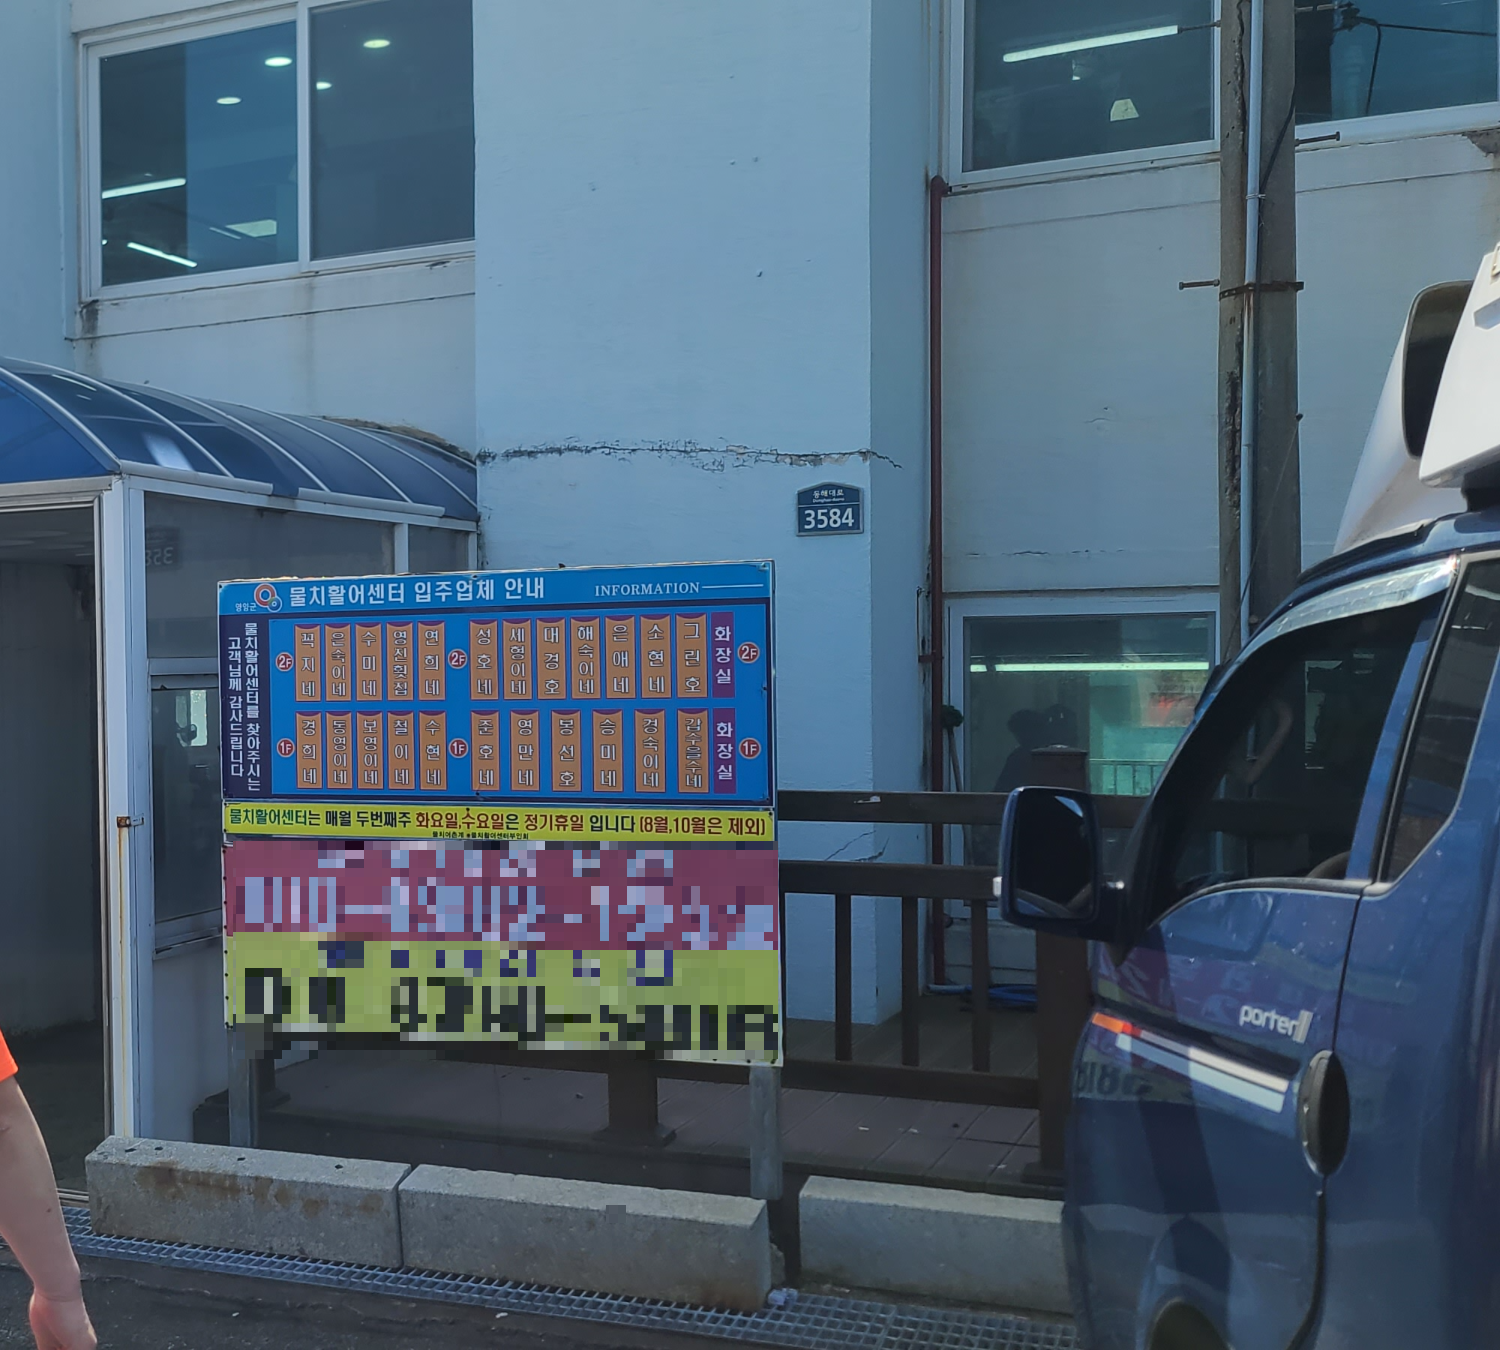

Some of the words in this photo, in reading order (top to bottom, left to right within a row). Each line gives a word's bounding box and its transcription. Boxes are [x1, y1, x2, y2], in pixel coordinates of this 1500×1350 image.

[804, 507, 854, 529] 3584
[289, 582, 405, 607] 물치활어센터
[415, 579, 494, 603] 입주업체
[504, 577, 544, 600] 안내
[595, 581, 700, 597] INFORMATION
[228, 637, 242, 691] 고객님께
[244, 622, 259, 719] 물치활어센터를
[278, 655, 292, 669] 2F
[331, 632, 346, 697] 은숙이네
[360, 631, 377, 696] 수미네
[393, 630, 408, 696] 영진횟집
[424, 629, 440, 696] 연희네
[450, 653, 466, 666] 2F
[476, 628, 493, 695] 성호네
[509, 627, 526, 695] 세형이네
[544, 626, 560, 695] 대경호
[577, 625, 594, 695] 해숙이네
[612, 624, 629, 694] 은애네
[647, 624, 665, 694] 소현네
[683, 623, 700, 693] 그린호
[714, 625, 732, 684] 화장실
[741, 645, 758, 660] 2F
[229, 696, 244, 777] 감사드립니다
[246, 723, 261, 791] 찾아주시는
[280, 741, 293, 754] 1F
[302, 720, 317, 785] 경희네
[332, 720, 348, 785] 동영이네
[363, 720, 378, 785] 보영이네
[393, 719, 409, 785] 철이네
[425, 719, 441, 785] 수현네
[451, 741, 465, 754] 1F
[478, 719, 494, 786] 준호네
[517, 719, 534, 787] 영만네
[559, 718, 575, 788] 봉선호
[600, 718, 617, 788] 승미네
[642, 718, 660, 788] 경숙이네
[716, 722, 733, 780] 화장실
[742, 741, 758, 755] 1F
[229, 808, 321, 826] 물치활어센터는
[325, 810, 352, 827] 매월
[356, 810, 412, 828] 두번째주
[415, 811, 520, 831] 화요일,수요일은
[524, 813, 584, 832] 정기휴일
[589, 814, 635, 832] 입니다
[728, 817, 766, 836] 제외)
